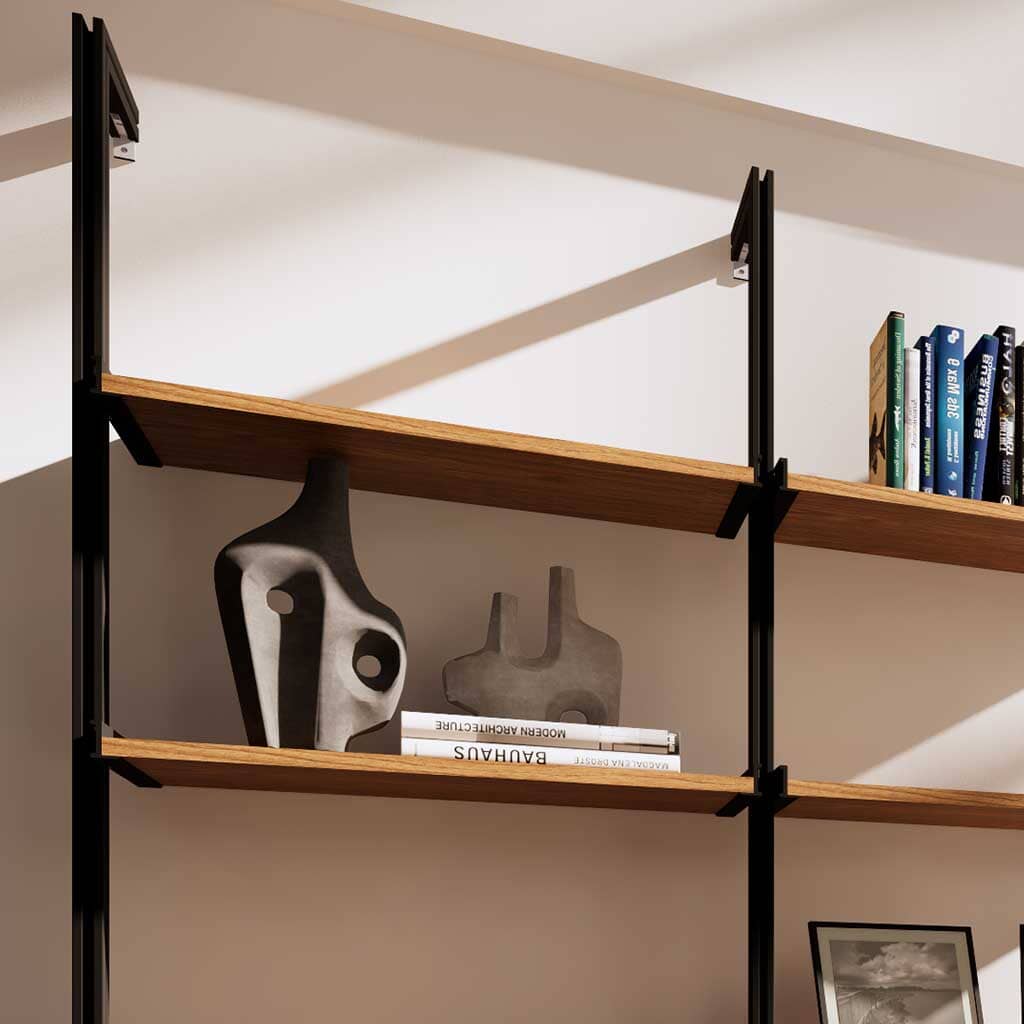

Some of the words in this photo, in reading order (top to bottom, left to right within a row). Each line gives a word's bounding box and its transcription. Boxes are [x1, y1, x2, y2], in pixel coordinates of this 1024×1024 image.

[436, 720, 518, 735] ARCHITECTURE
[520, 725, 566, 739] MODERN
[454, 746, 547, 765] BAUHAUS
[611, 758, 669, 770] MAGDALENA
